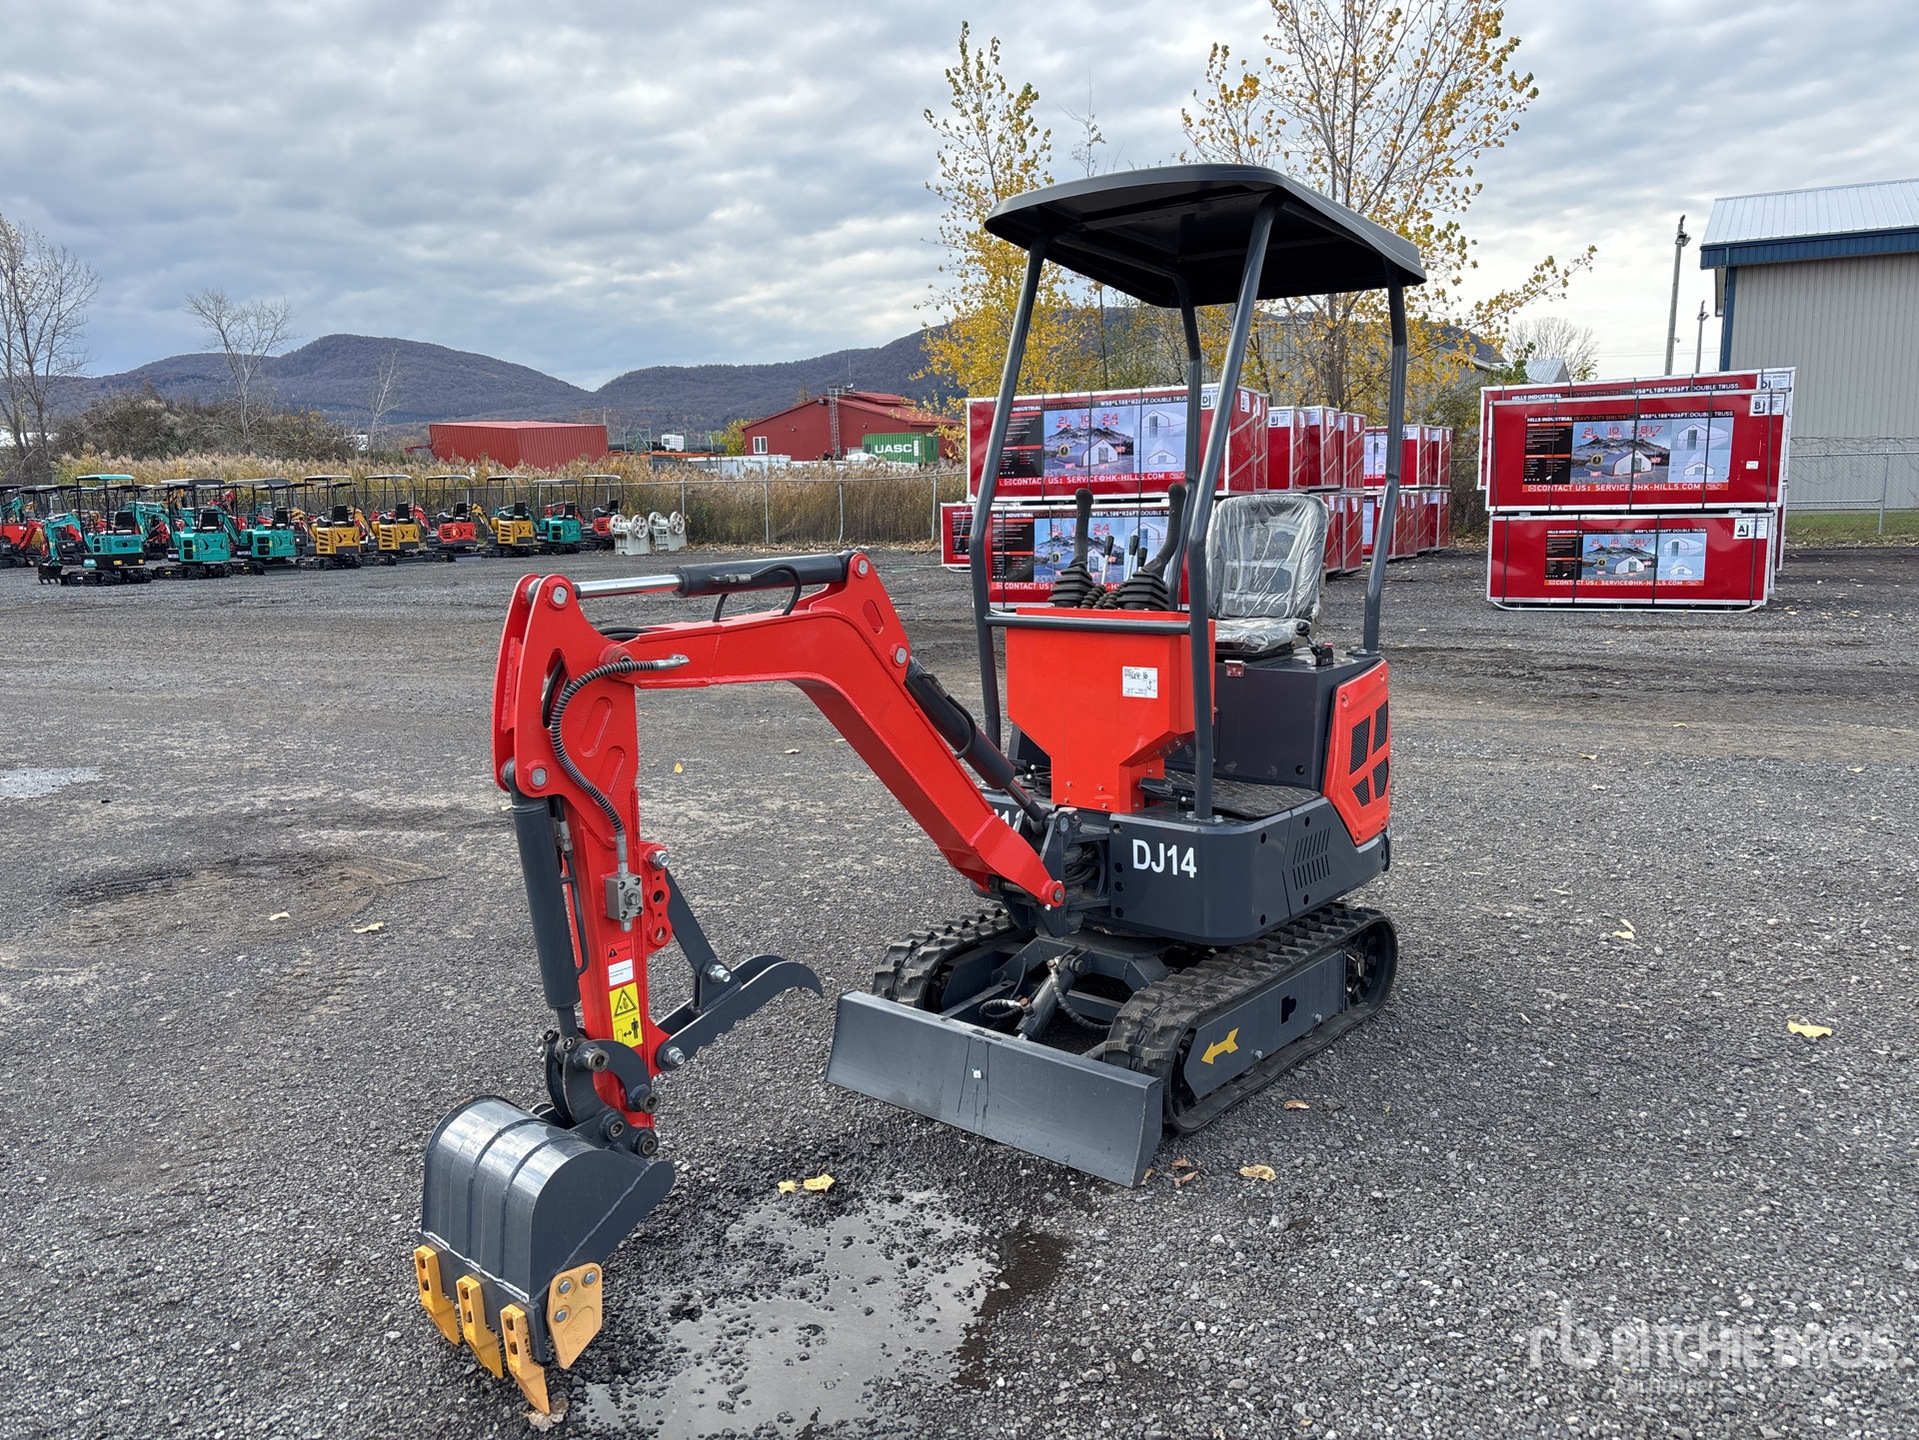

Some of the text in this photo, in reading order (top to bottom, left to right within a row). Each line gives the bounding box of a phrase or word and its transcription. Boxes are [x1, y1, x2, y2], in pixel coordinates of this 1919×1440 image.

[1718, 382, 1740, 390] TRUSS
[1150, 396, 1172, 404] DOUBLE
[875, 444, 912, 454] UASC
[1012, 477, 1046, 486] CONTAC
[1536, 483, 1574, 492] CONTACT
[1003, 582, 1037, 590] CONTACT
[1132, 838, 1197, 878] DJ14
